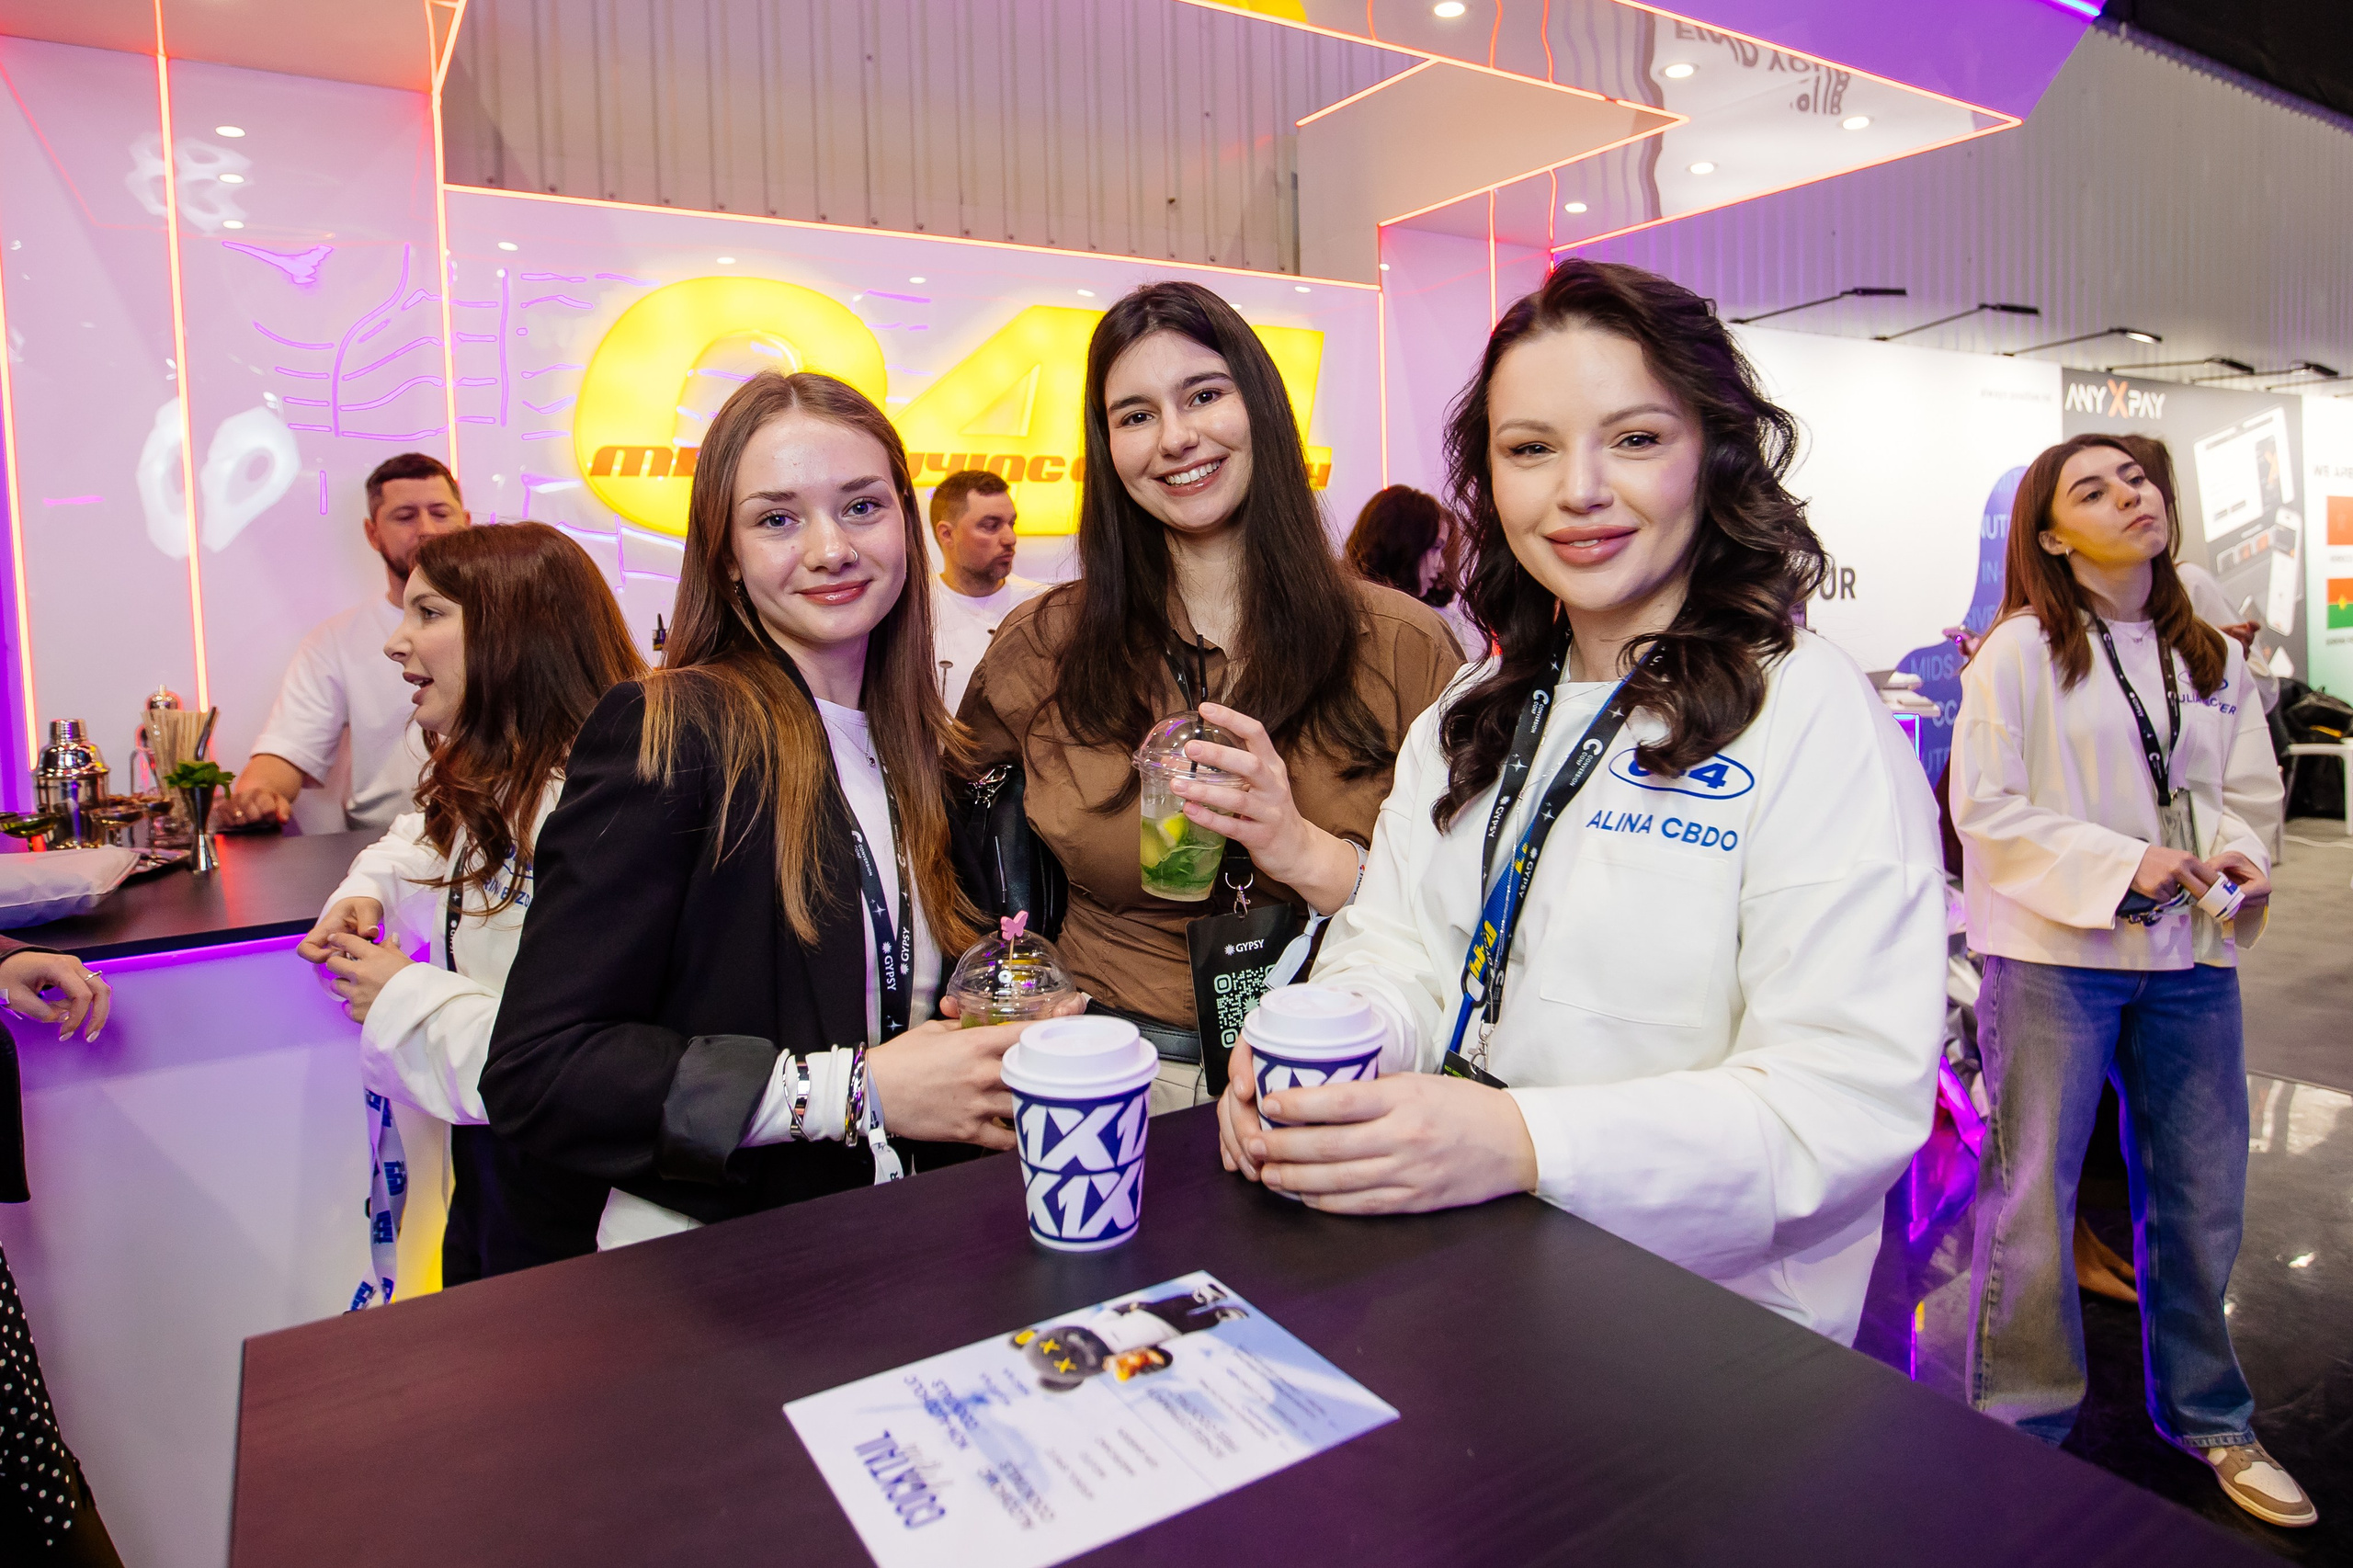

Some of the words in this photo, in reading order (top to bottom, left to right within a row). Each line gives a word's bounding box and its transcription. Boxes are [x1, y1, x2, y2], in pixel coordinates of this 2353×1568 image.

[1586, 810, 1654, 834] ALINA
[1661, 817, 1738, 851] CBDO
[1518, 861, 1534, 898] GYPSY
[901, 926, 910, 961] GYPSY
[1235, 938, 1265, 952] GYPSY
[886, 955, 897, 991] GYPSY
[854, 1428, 946, 1530] COCKTAIL
